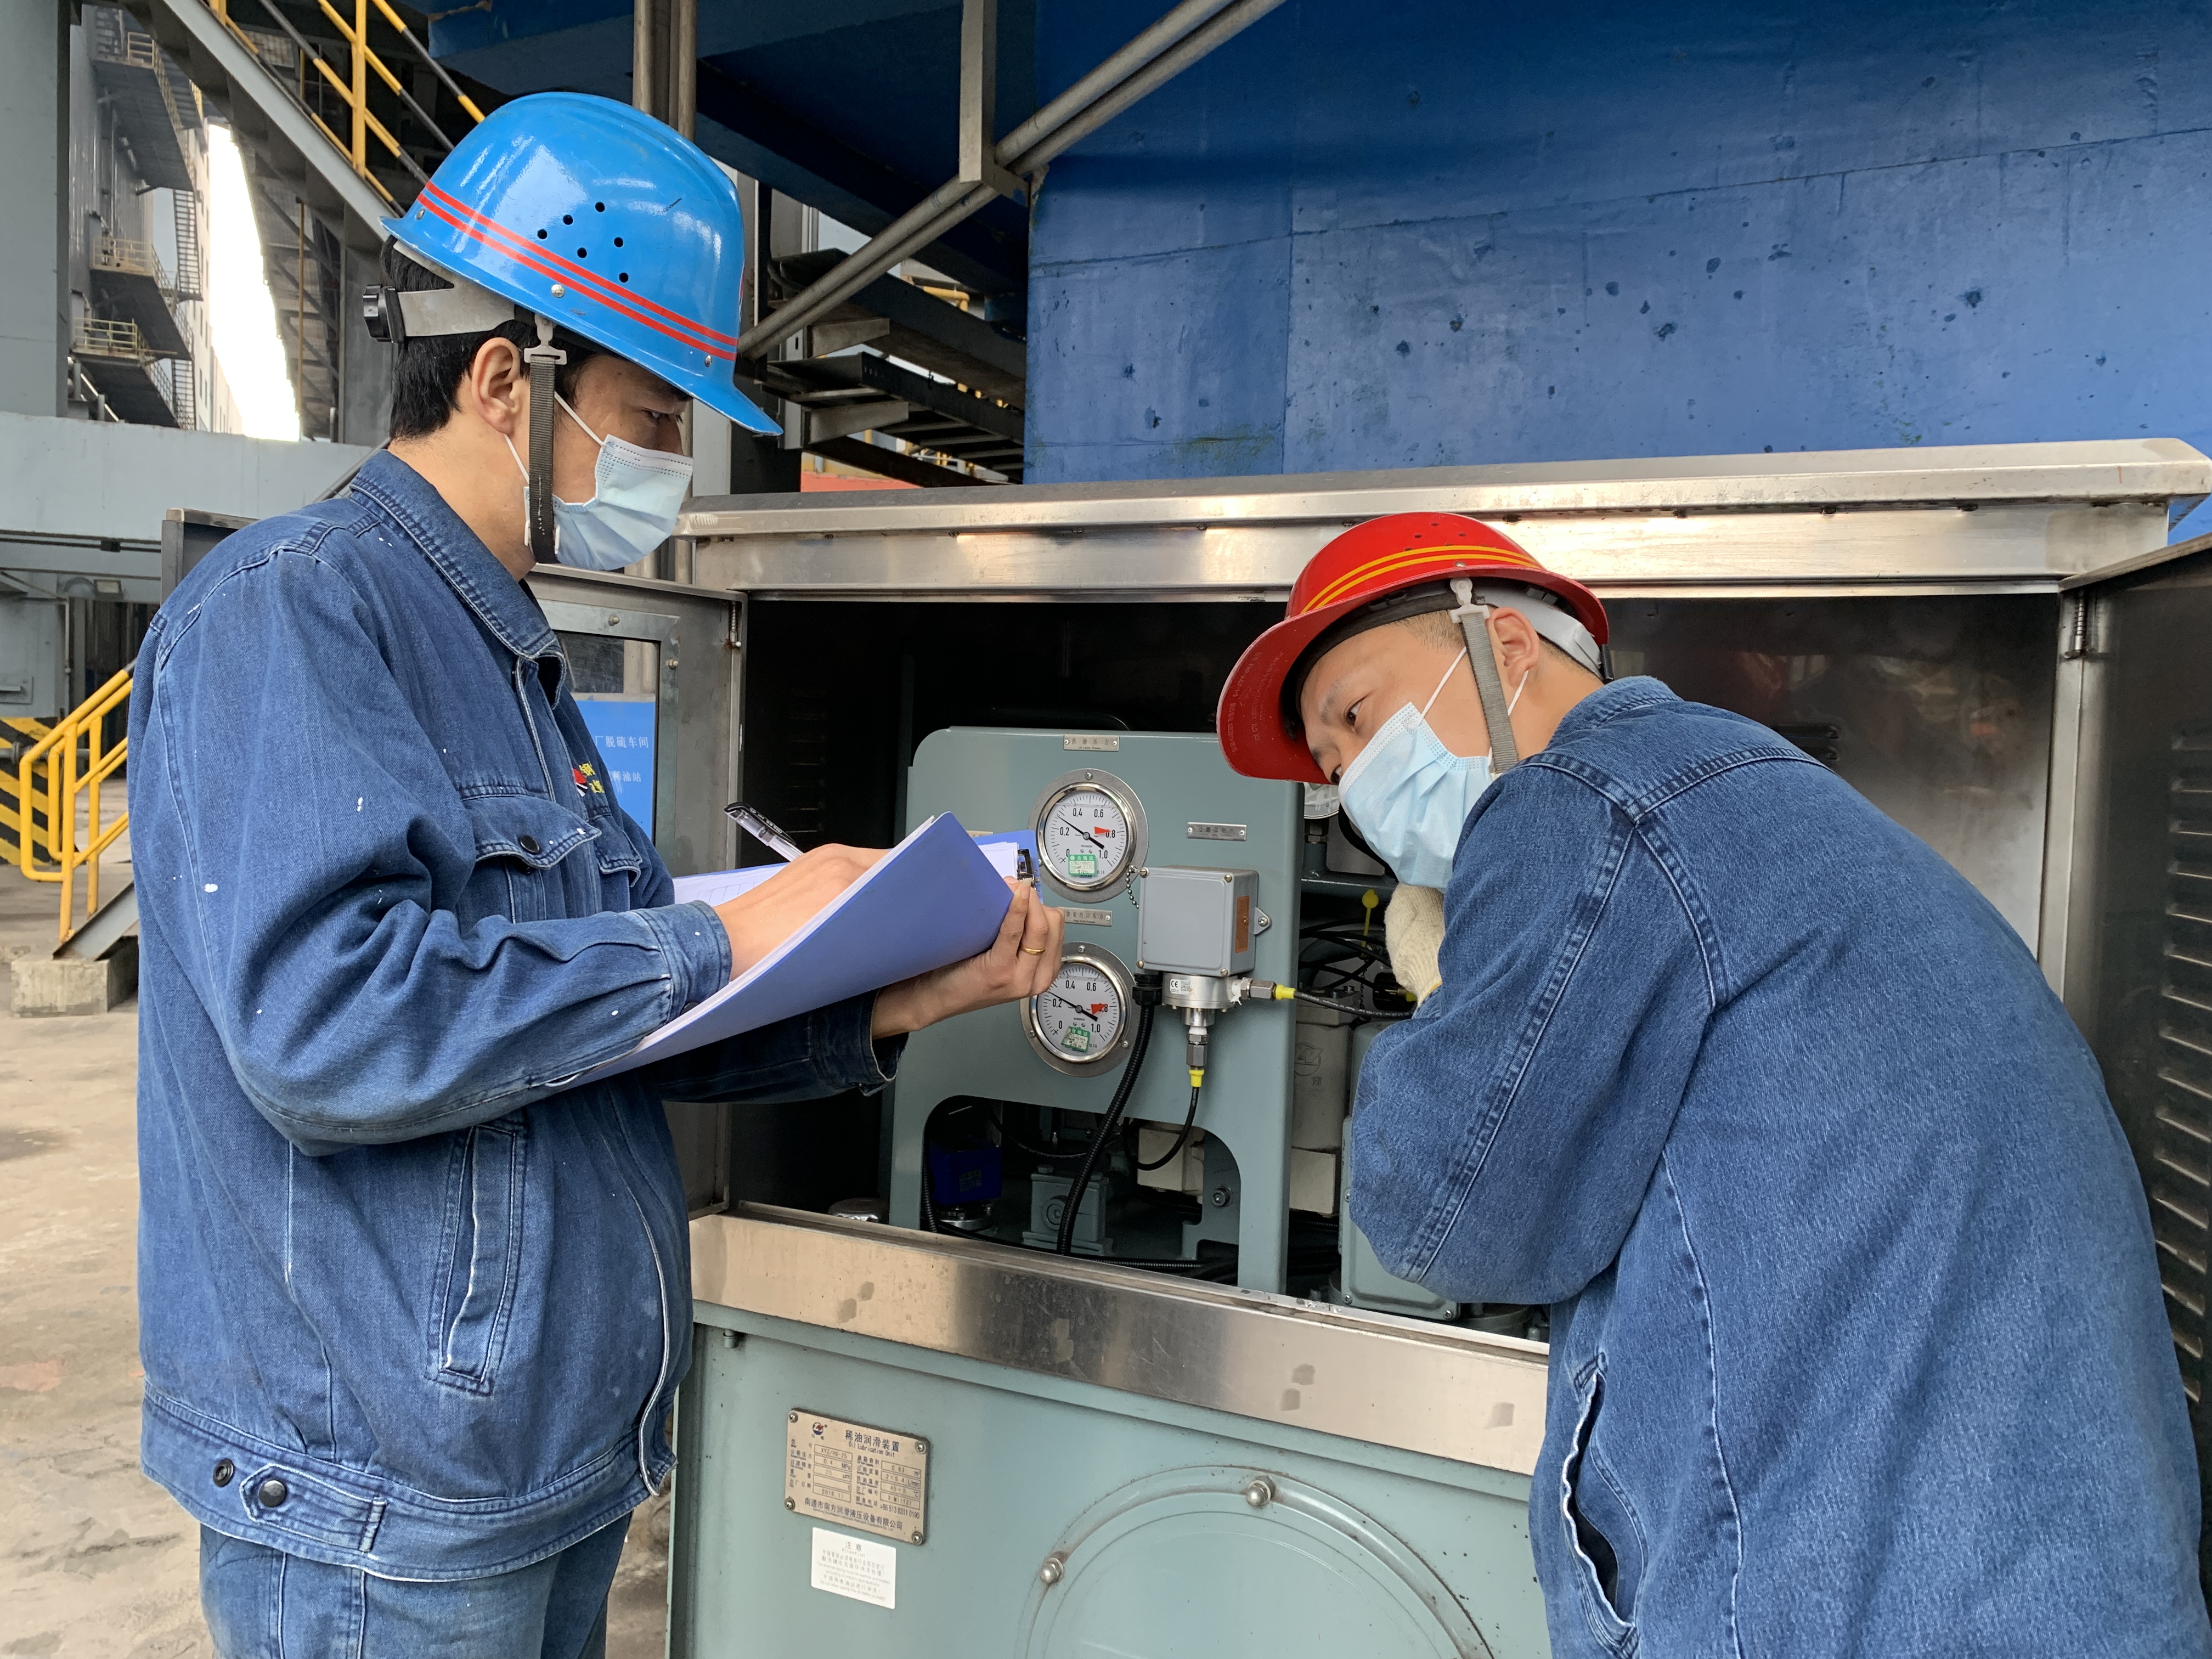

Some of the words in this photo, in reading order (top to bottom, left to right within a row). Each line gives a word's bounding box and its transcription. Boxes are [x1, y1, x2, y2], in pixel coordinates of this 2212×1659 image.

[595, 736, 649, 748] 厂脱硫车间
[608, 771, 641, 782] 稀油站
[1066, 849, 1070, 857] 0
[1059, 1020, 1063, 1029] 0
[1071, 1028, 1088, 1037] 合格证
[845, 1429, 899, 1452] 稀油润滑装置
[857, 1443, 883, 1455] Lubrication
[885, 1449, 895, 1458] Unit
[804, 1497, 902, 1531] 南通市南方润滑液压设备有限公司
[845, 1542, 862, 1551] 注意
